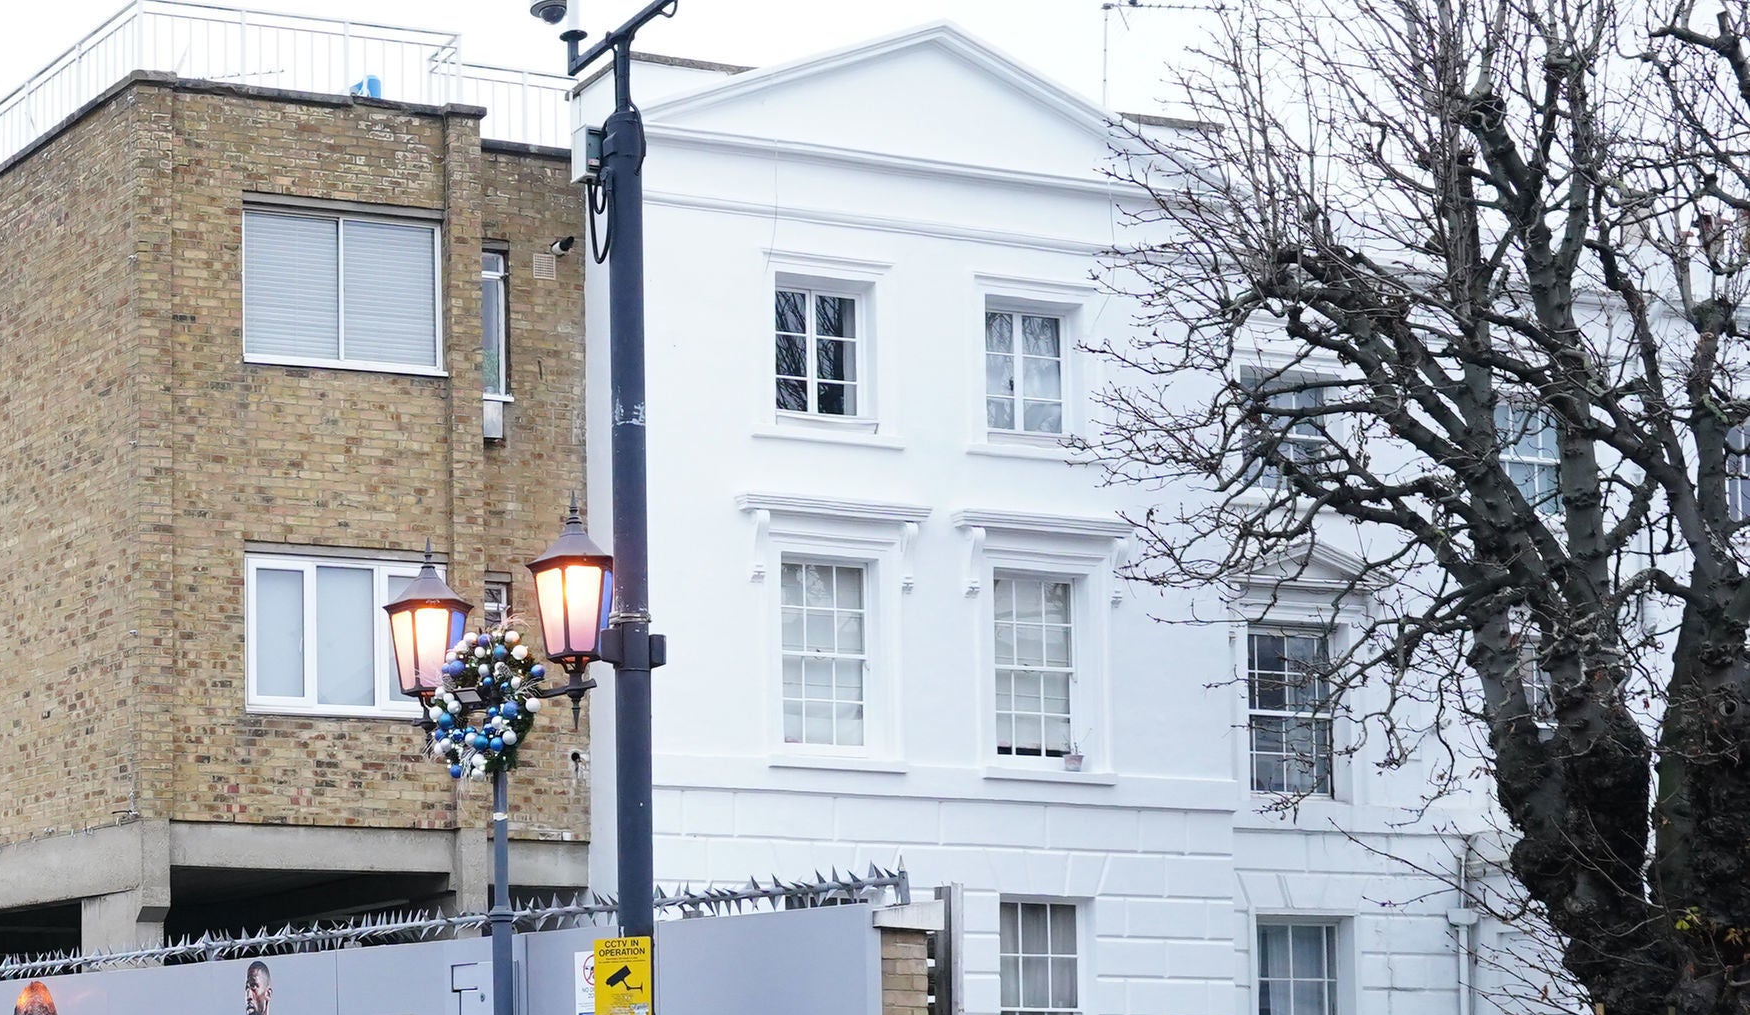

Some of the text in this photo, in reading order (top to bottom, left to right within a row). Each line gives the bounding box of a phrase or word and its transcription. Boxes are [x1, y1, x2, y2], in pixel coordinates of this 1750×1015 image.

[604, 939, 639, 948] CCTV IN
[598, 947, 645, 957] OPERATION
